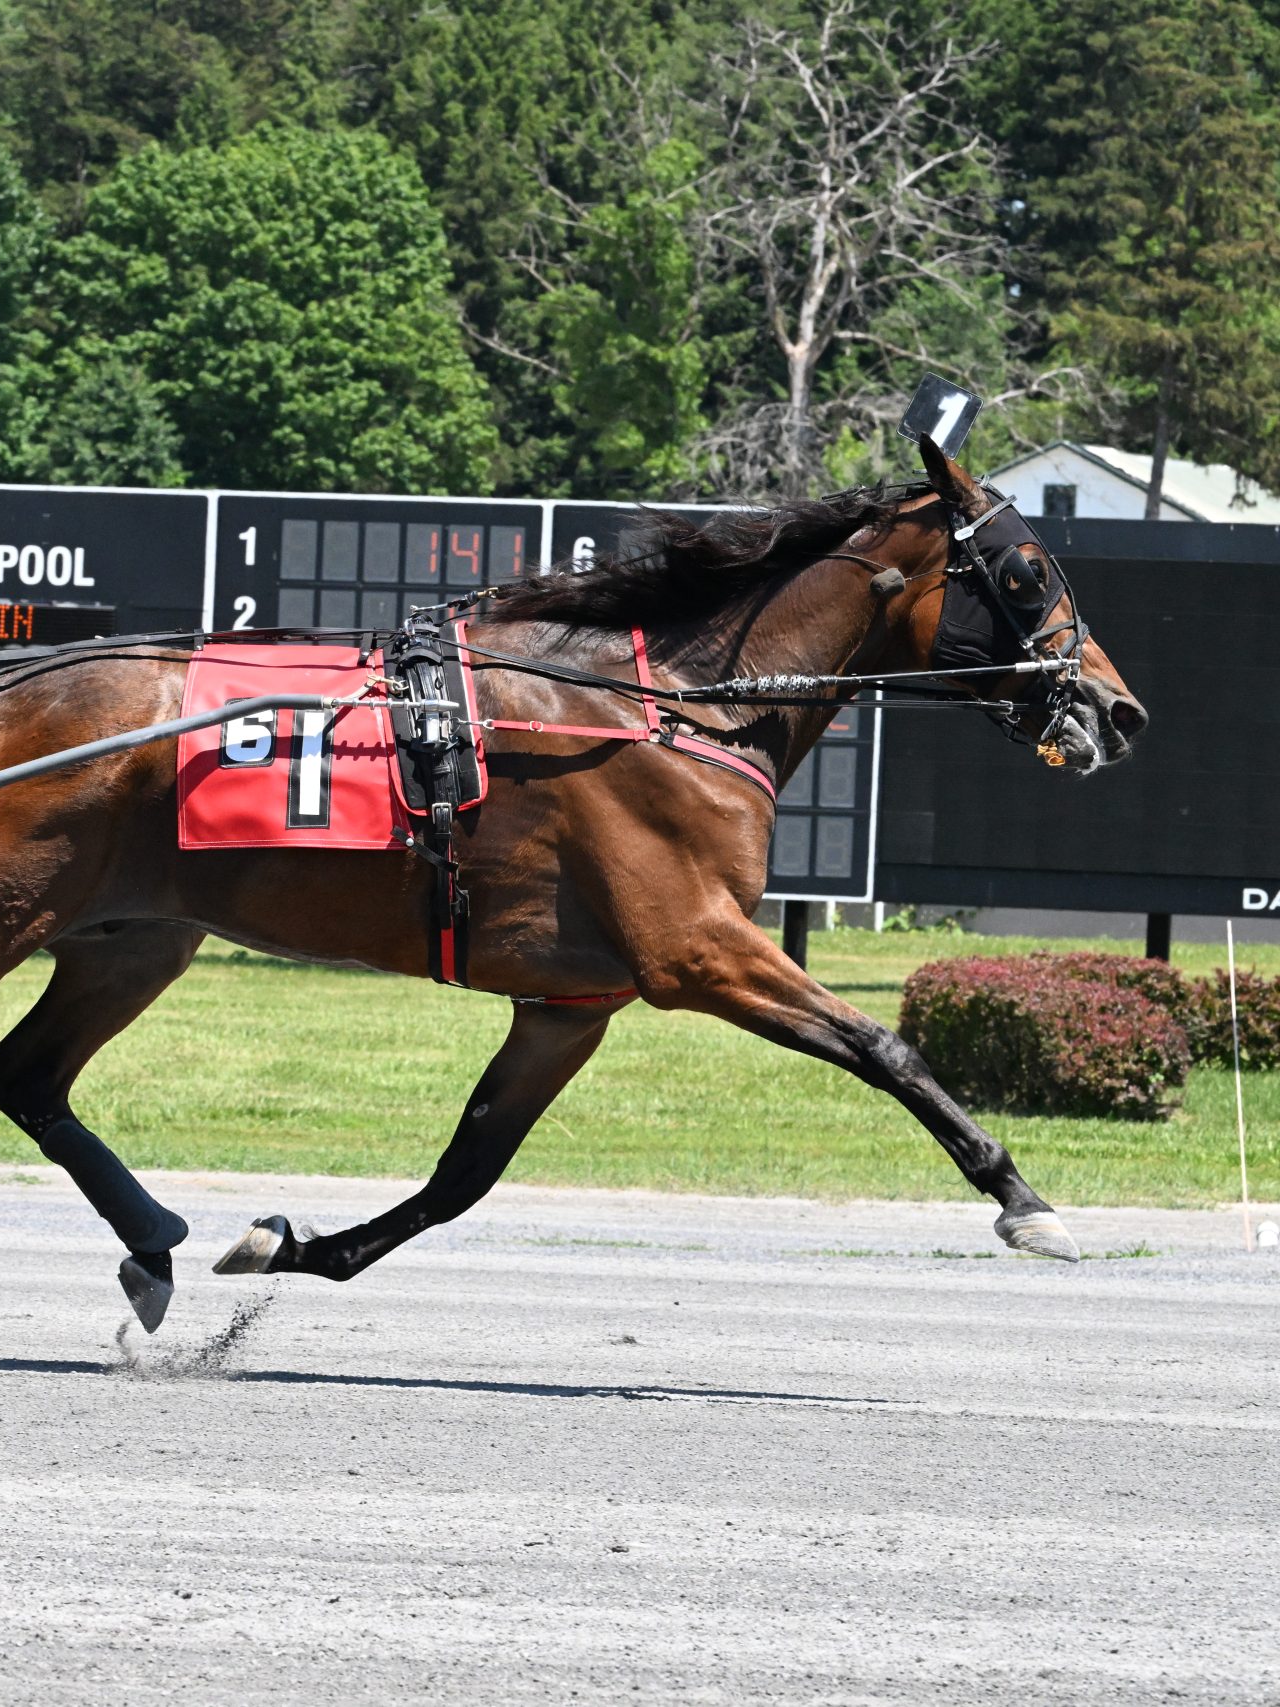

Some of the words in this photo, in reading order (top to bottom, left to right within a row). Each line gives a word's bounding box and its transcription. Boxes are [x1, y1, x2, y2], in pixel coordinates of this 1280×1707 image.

[930, 392, 969, 448] 1
[238, 526, 257, 566] 1
[572, 536, 597, 574] 6
[233, 596, 257, 631] 2
[224, 709, 274, 762] 6
[298, 711, 326, 816] 1
